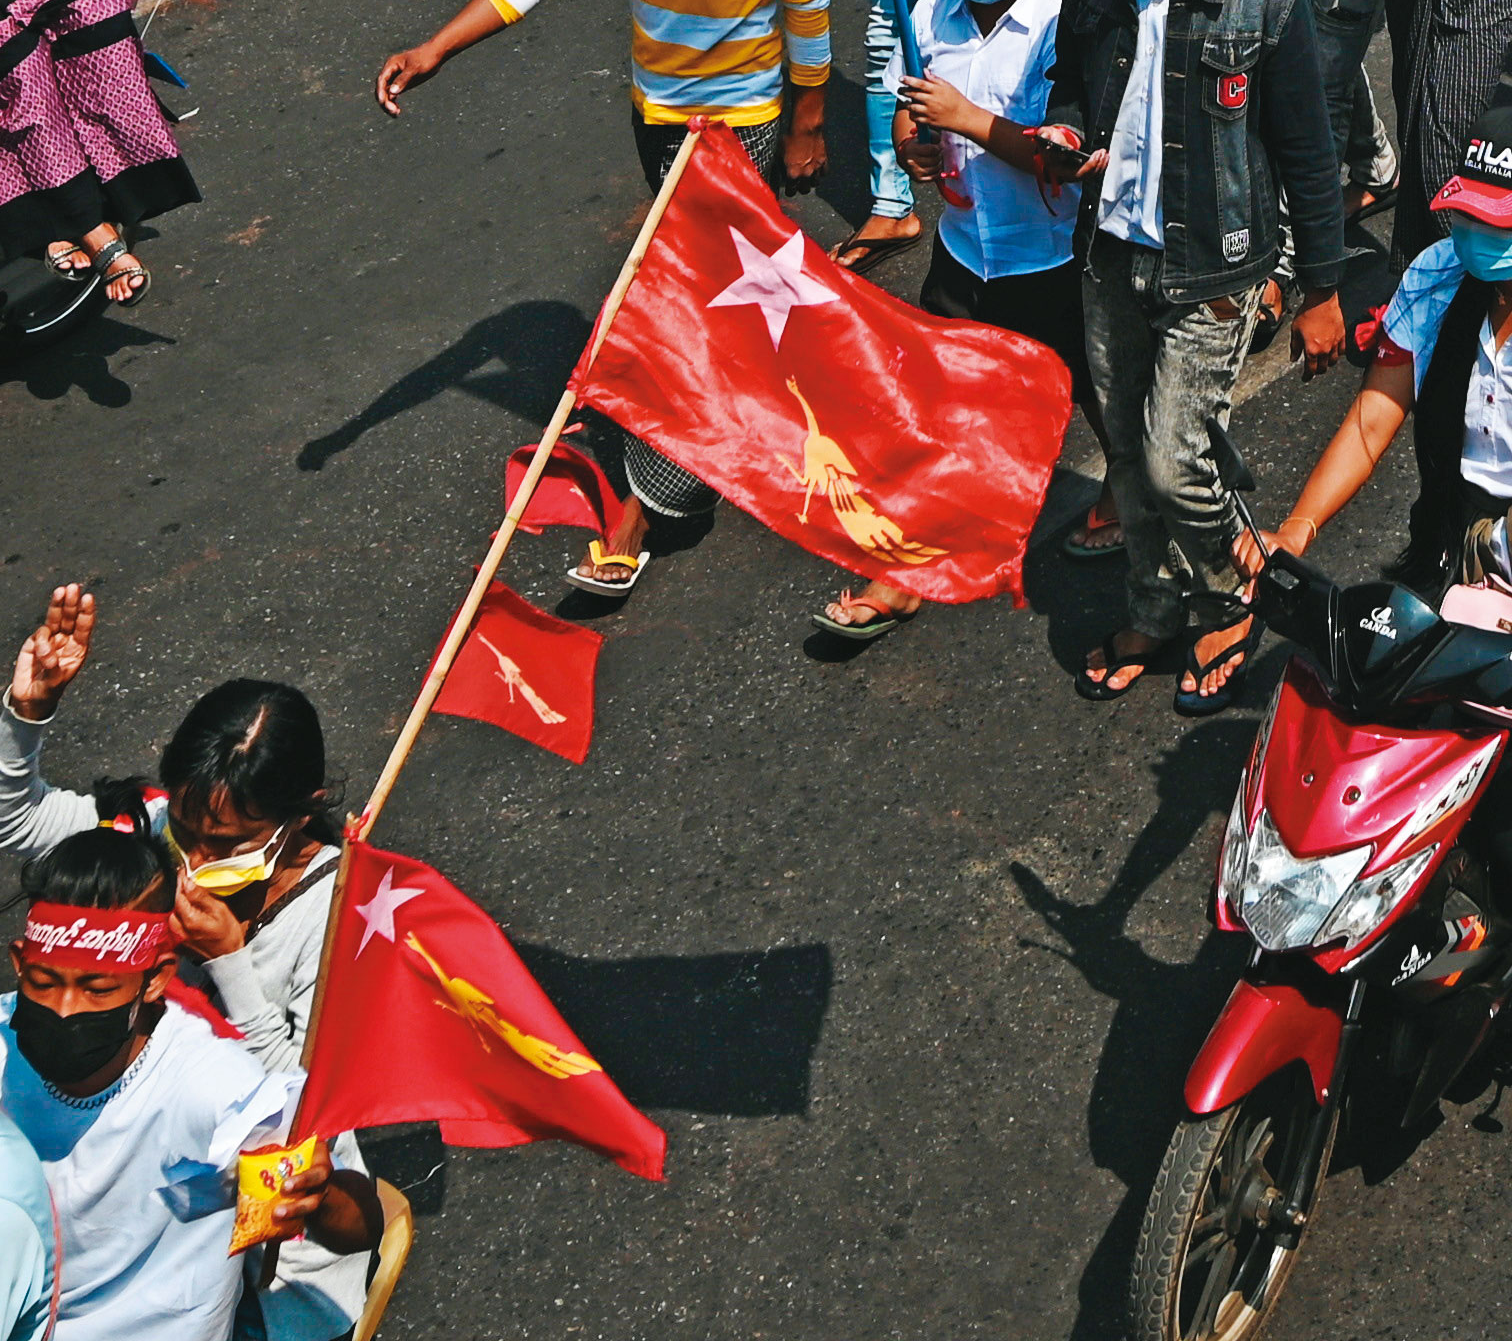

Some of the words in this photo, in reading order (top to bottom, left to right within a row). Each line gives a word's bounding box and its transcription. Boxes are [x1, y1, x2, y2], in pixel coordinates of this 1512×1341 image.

[1218, 73, 1248, 109] C
[1485, 164, 1512, 179] ITALIA
[1360, 618, 1397, 640] CANDA
